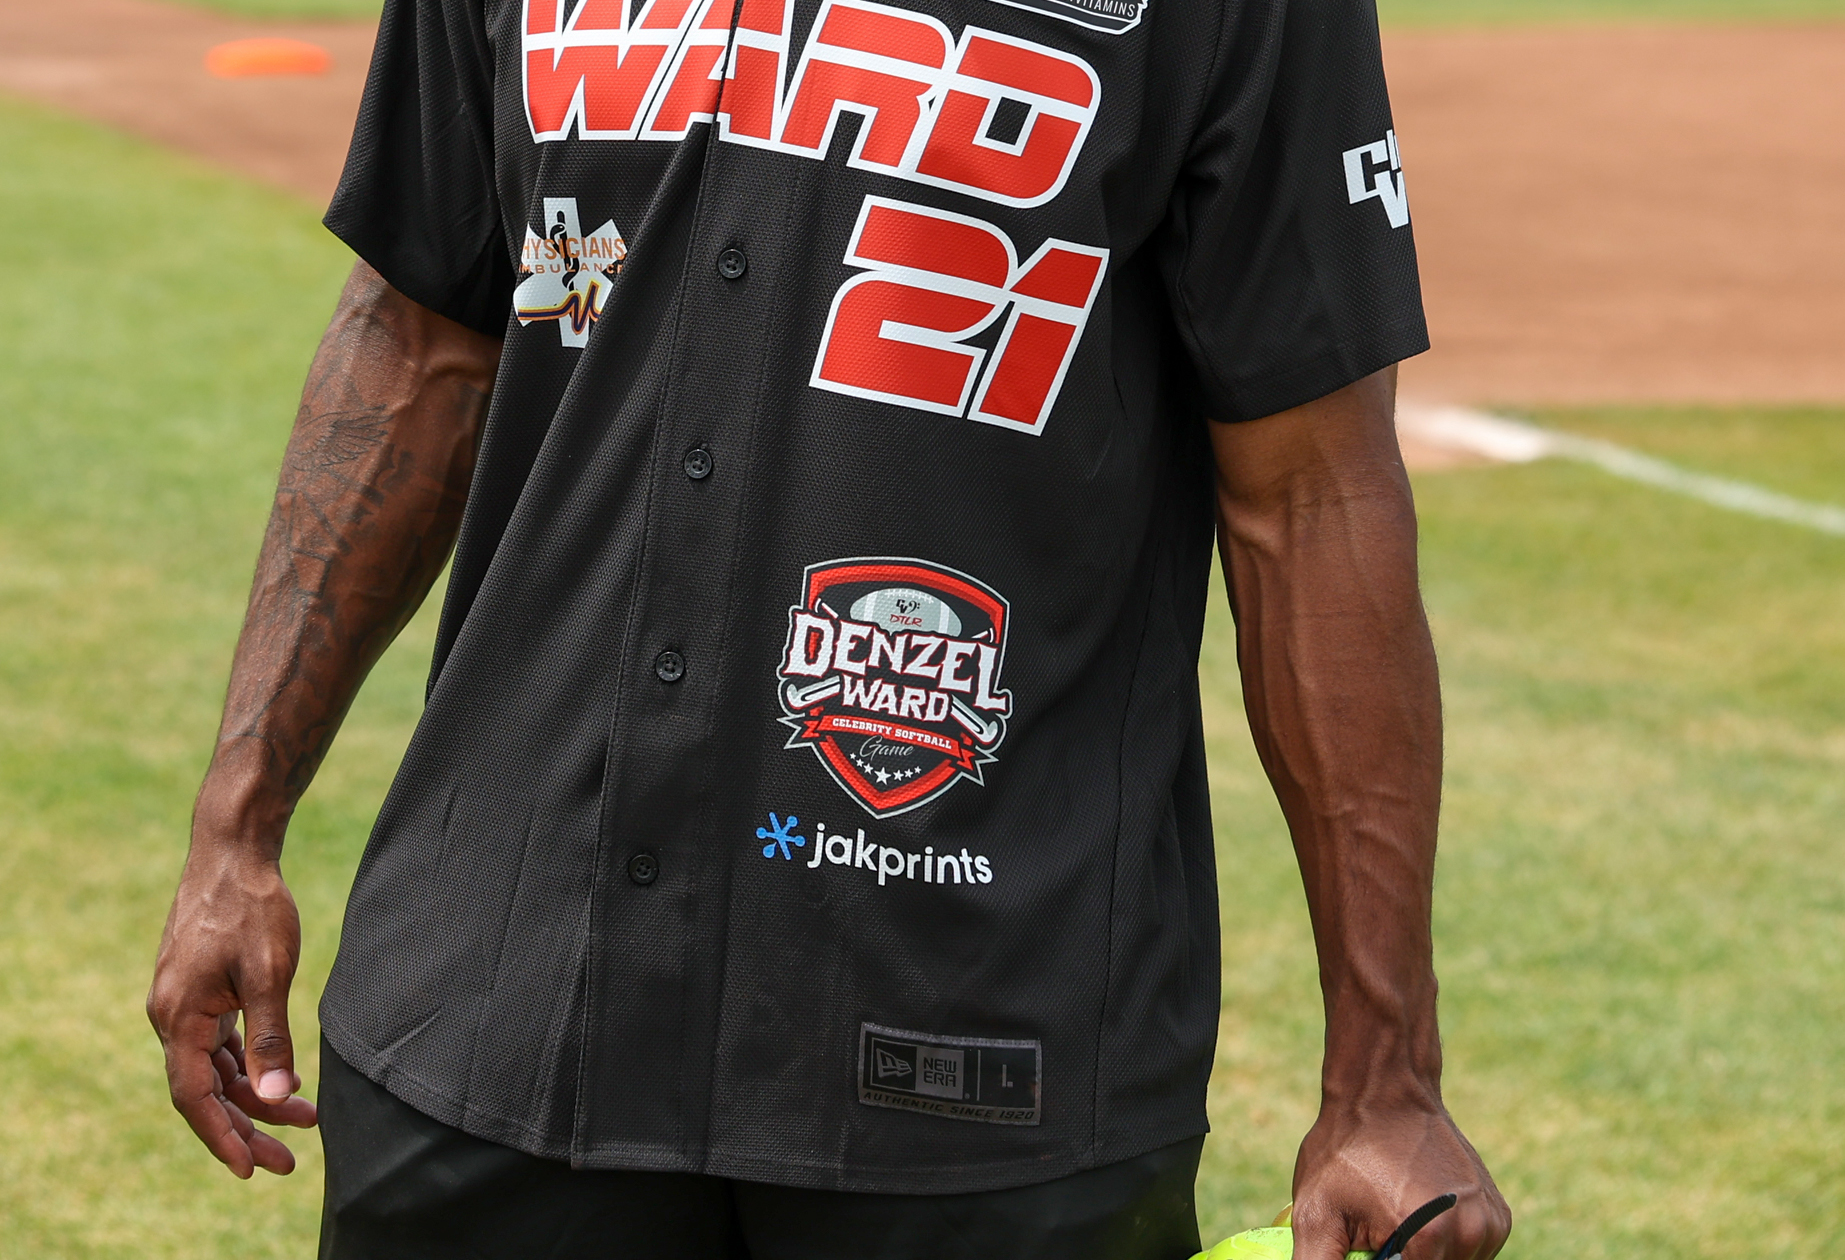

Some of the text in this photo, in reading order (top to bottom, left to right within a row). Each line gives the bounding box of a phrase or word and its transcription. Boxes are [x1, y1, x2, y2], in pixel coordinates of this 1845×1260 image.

[522, 236, 626, 261] HYSICIANS
[808, 194, 1110, 437] 21
[889, 613, 923, 627] DTLR
[783, 611, 1008, 712] DENZEL
[841, 674, 950, 723] WARD
[832, 717, 953, 750] CELEBRITY SOFTBALL
[859, 734, 914, 762] Game
[806, 822, 993, 887] jakprints
[922, 1056, 957, 1074] NEW
[922, 1071, 957, 1088] ERA
[863, 1091, 1036, 1121] AUTHENTIC SINCE 1920
